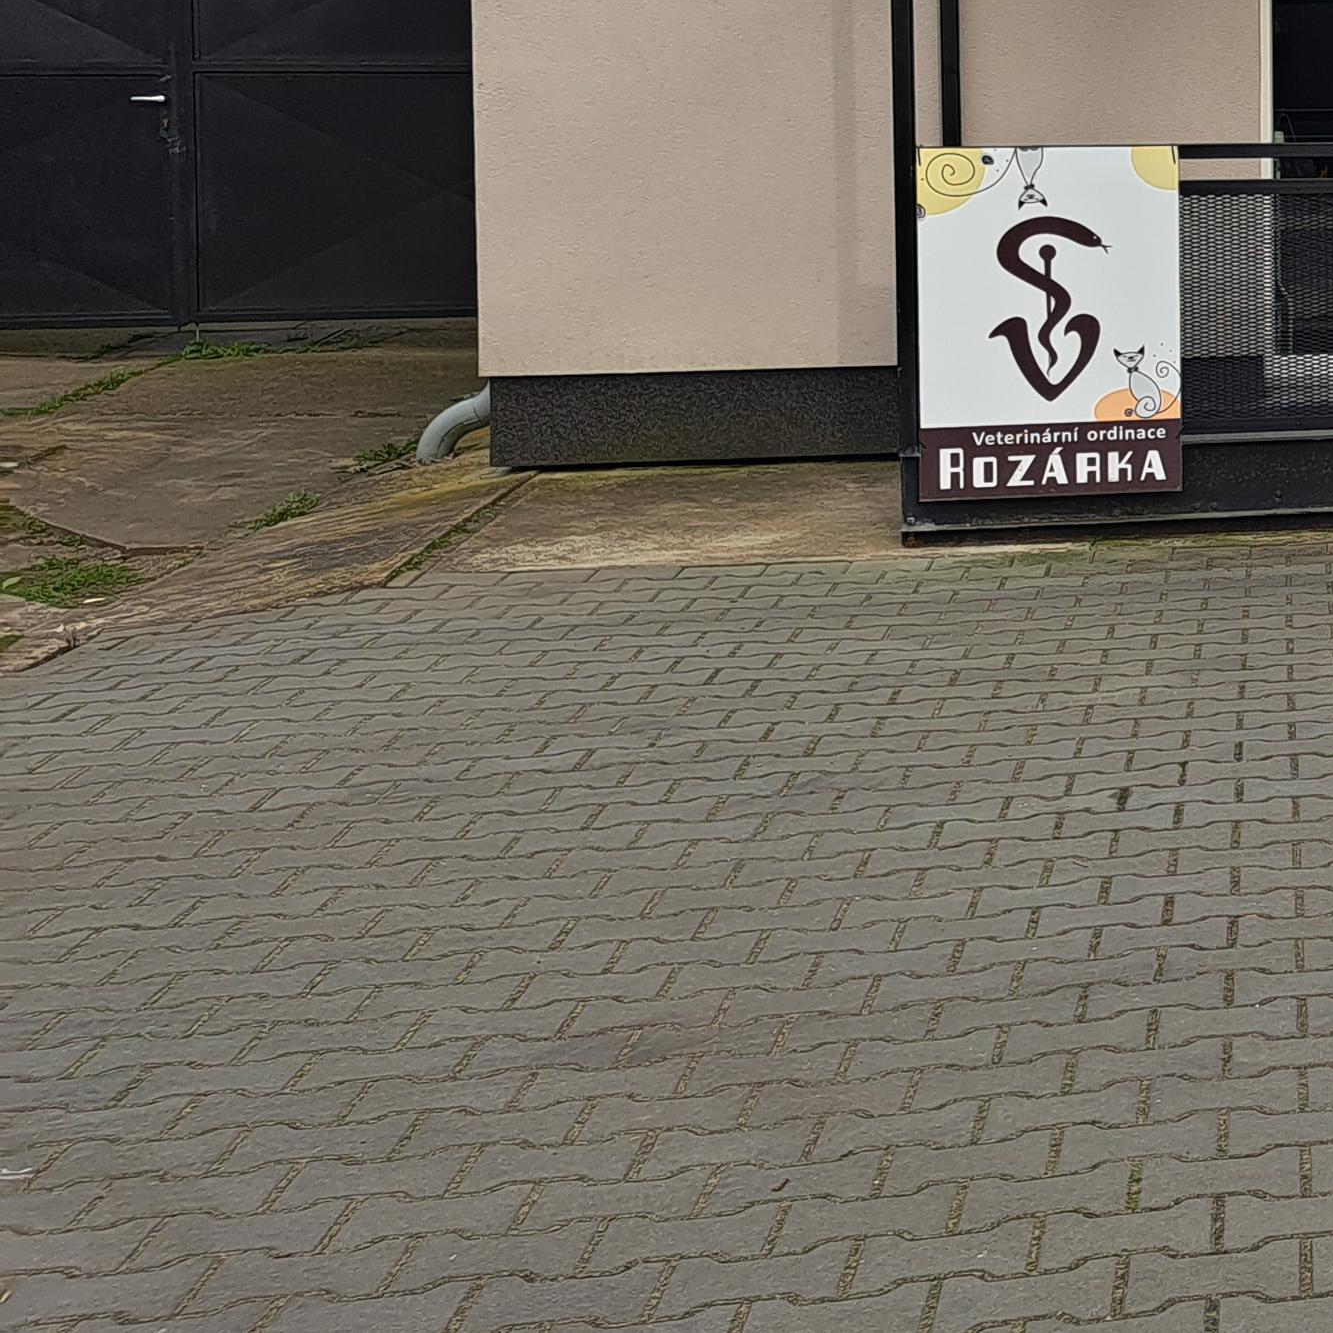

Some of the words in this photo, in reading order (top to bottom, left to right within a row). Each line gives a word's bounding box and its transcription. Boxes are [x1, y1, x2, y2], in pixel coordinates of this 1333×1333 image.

[972, 427, 1079, 446] Veterinární
[1086, 426, 1167, 442] ordinace
[939, 447, 1167, 490] ROZÁRKA
